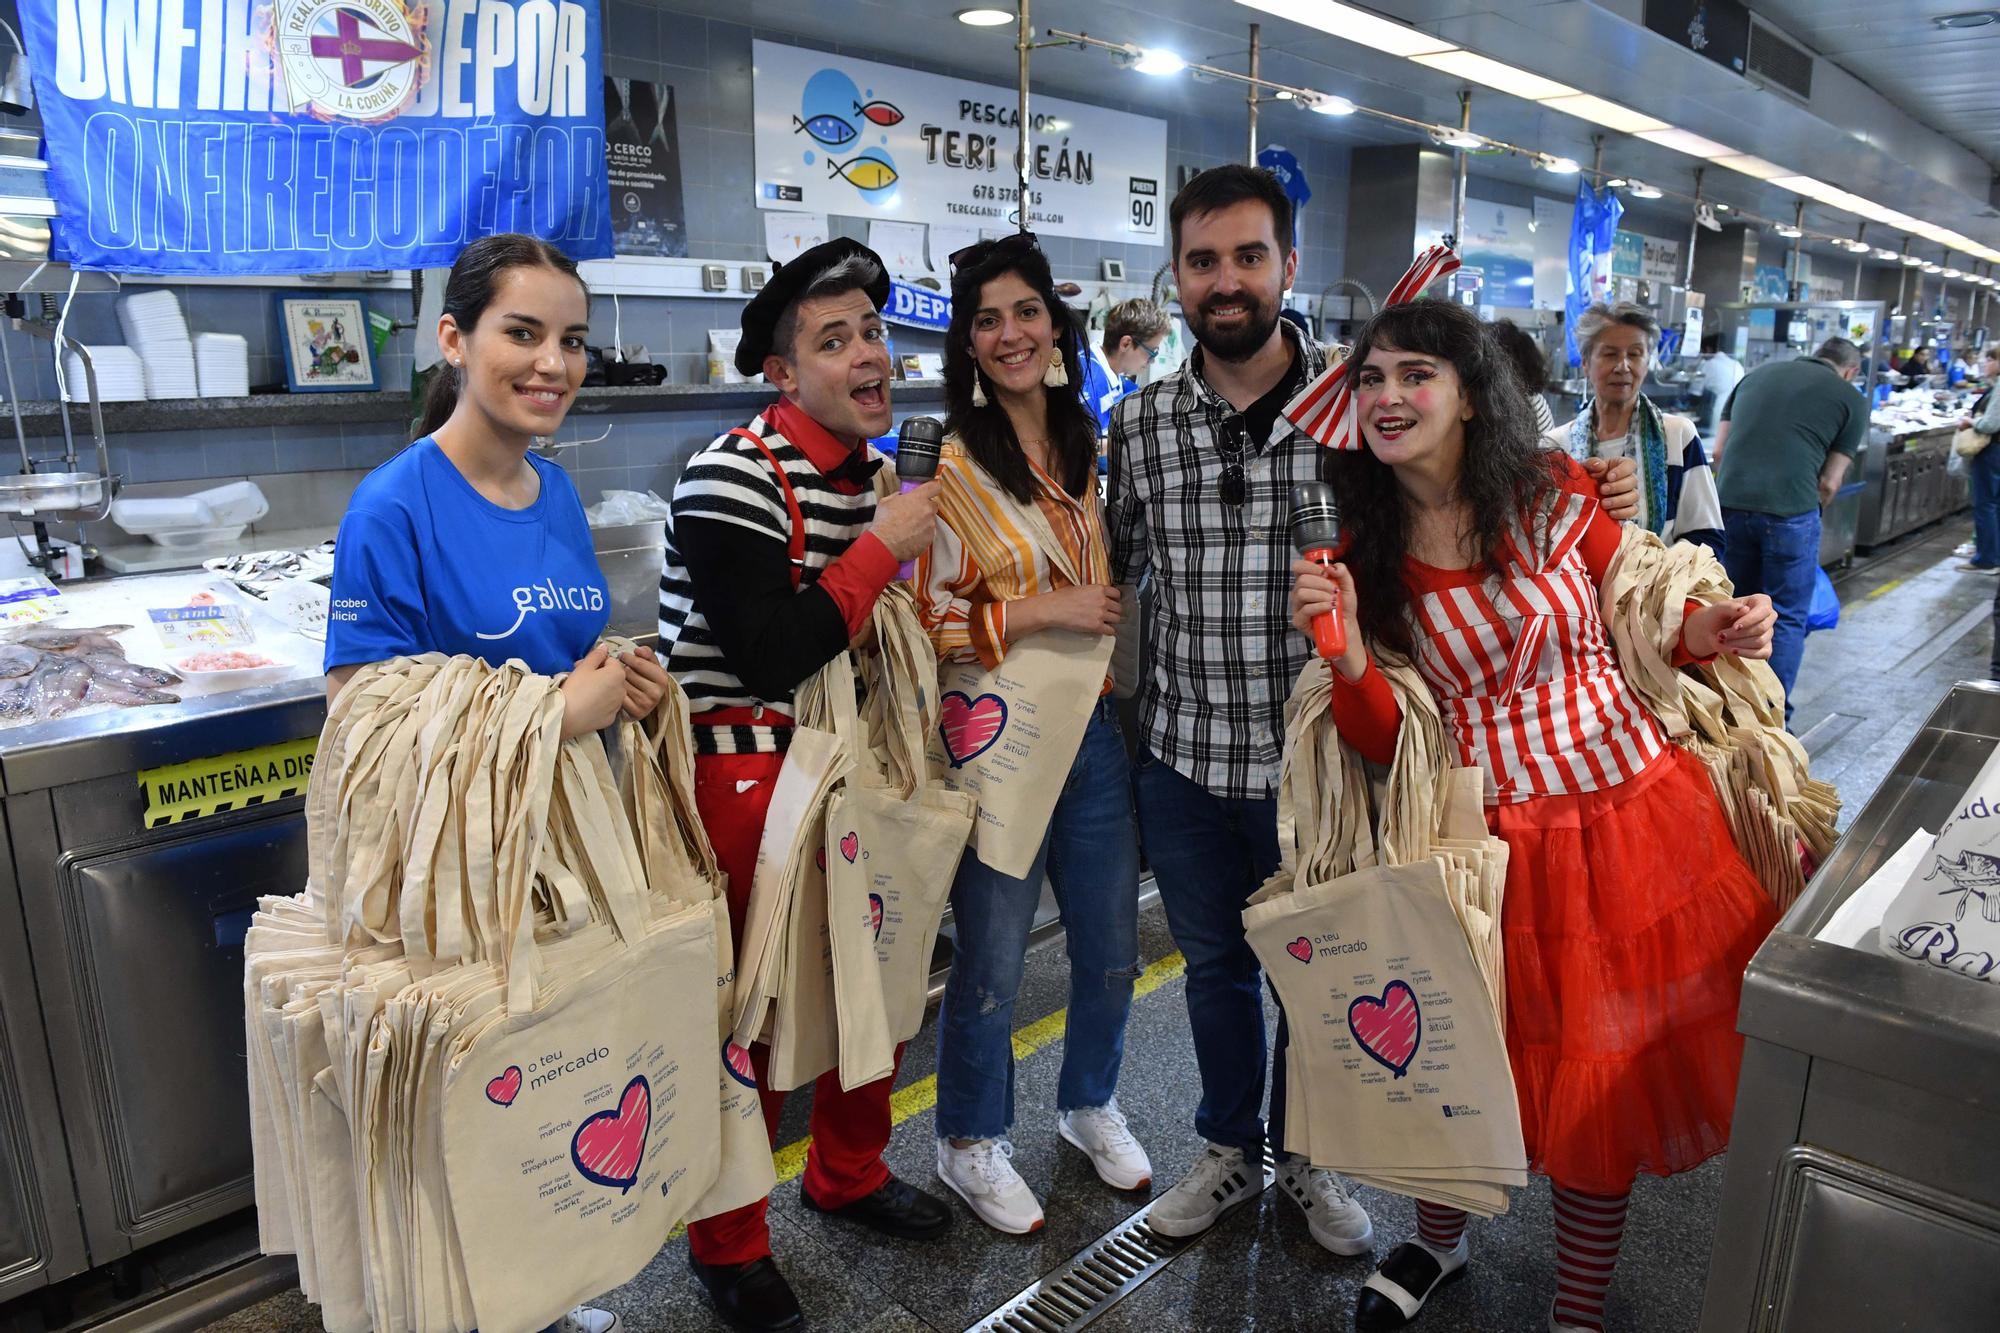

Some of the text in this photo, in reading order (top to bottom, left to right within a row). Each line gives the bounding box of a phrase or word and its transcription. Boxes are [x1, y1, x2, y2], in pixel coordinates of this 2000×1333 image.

[290, 0, 314, 32] REAL
[338, 94, 353, 109] LA
[357, 82, 399, 110] CORUÑA
[614, 143, 652, 157] CERCO
[973, 184, 995, 200] 678
[998, 188, 1018, 201] 378
[1132, 181, 1155, 193] PUESTO
[1132, 199, 1154, 227] 90
[476, 577, 603, 639] galicia
[159, 763, 263, 806] MANTEÑA
[267, 761, 281, 783] A
[1322, 932, 1340, 943] teu
[1319, 939, 1368, 957] mercado
[1422, 997, 1453, 1007] mercado
[528, 1050, 563, 1073] o teu
[530, 1047, 610, 1090] mercado
[1421, 1063, 1450, 1071] mercado
[584, 1087, 614, 1105] mercat
[540, 1119, 573, 1140] marché
[539, 1179, 573, 1199] market
[554, 1198, 580, 1214] markt
[580, 1199, 612, 1219] marked
